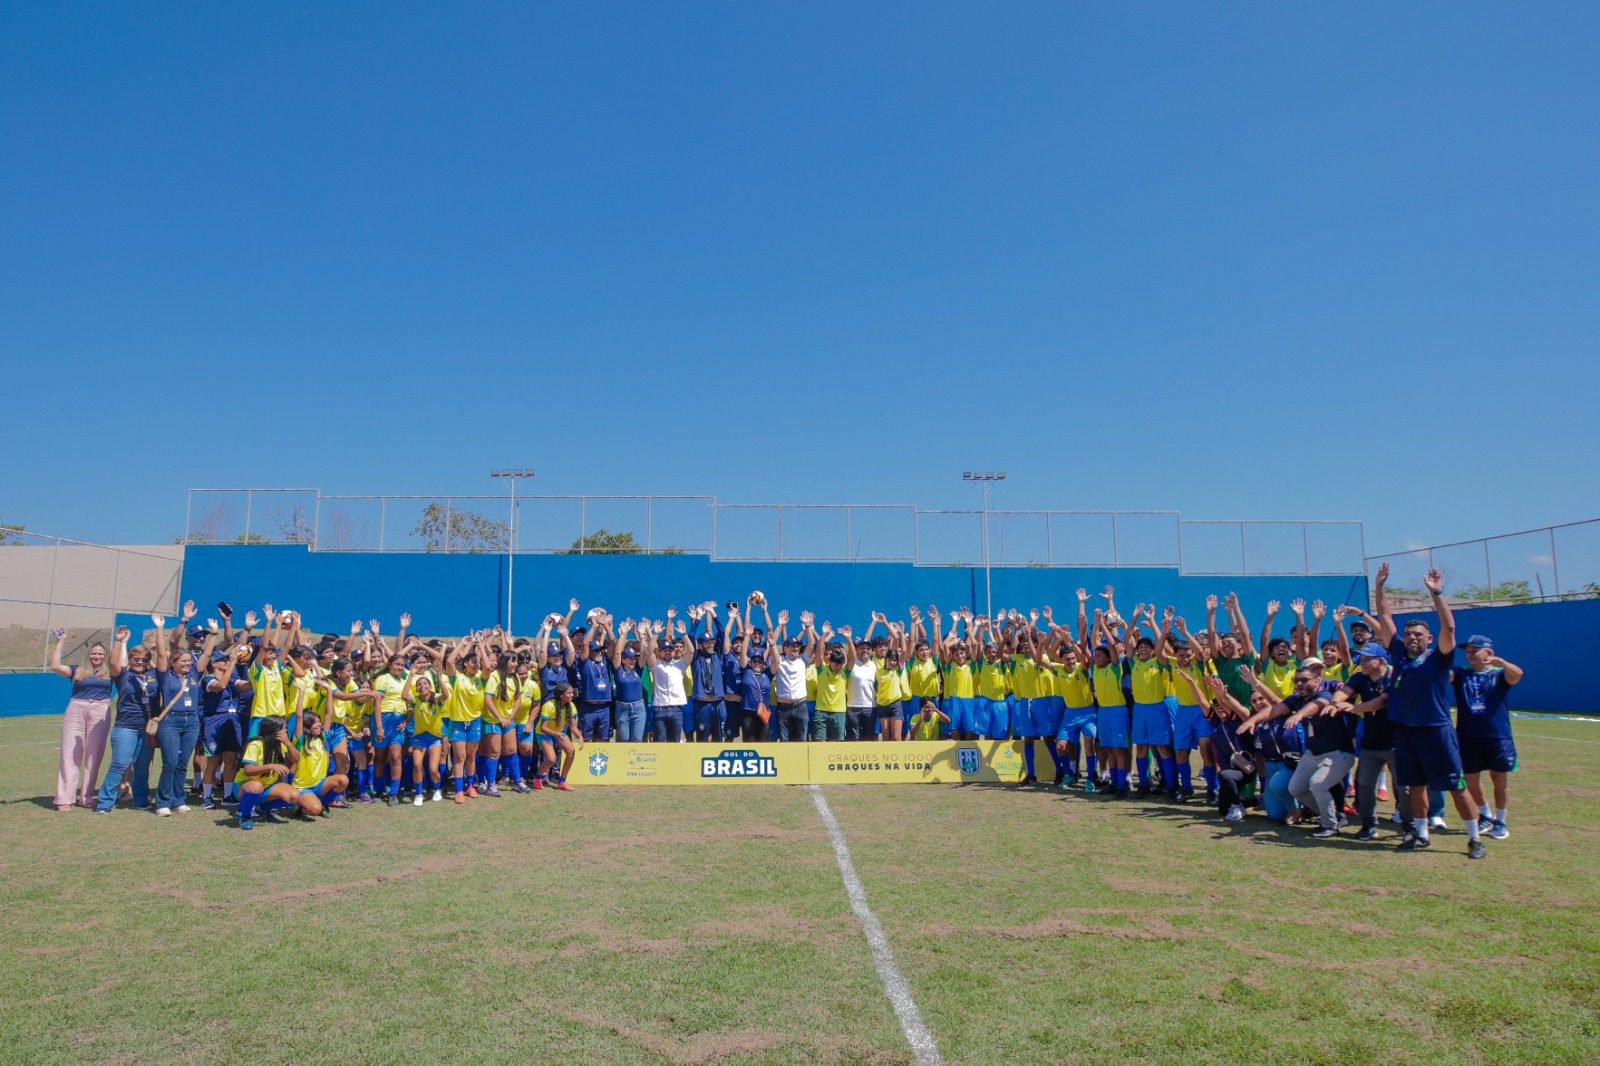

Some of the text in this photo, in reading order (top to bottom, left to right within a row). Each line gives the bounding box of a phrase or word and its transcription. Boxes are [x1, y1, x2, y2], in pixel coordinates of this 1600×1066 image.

[828, 753, 933, 762] CRAQUES NO JOGO
[703, 759, 775, 775] BRASIL
[828, 763, 880, 771] CRAQUES
